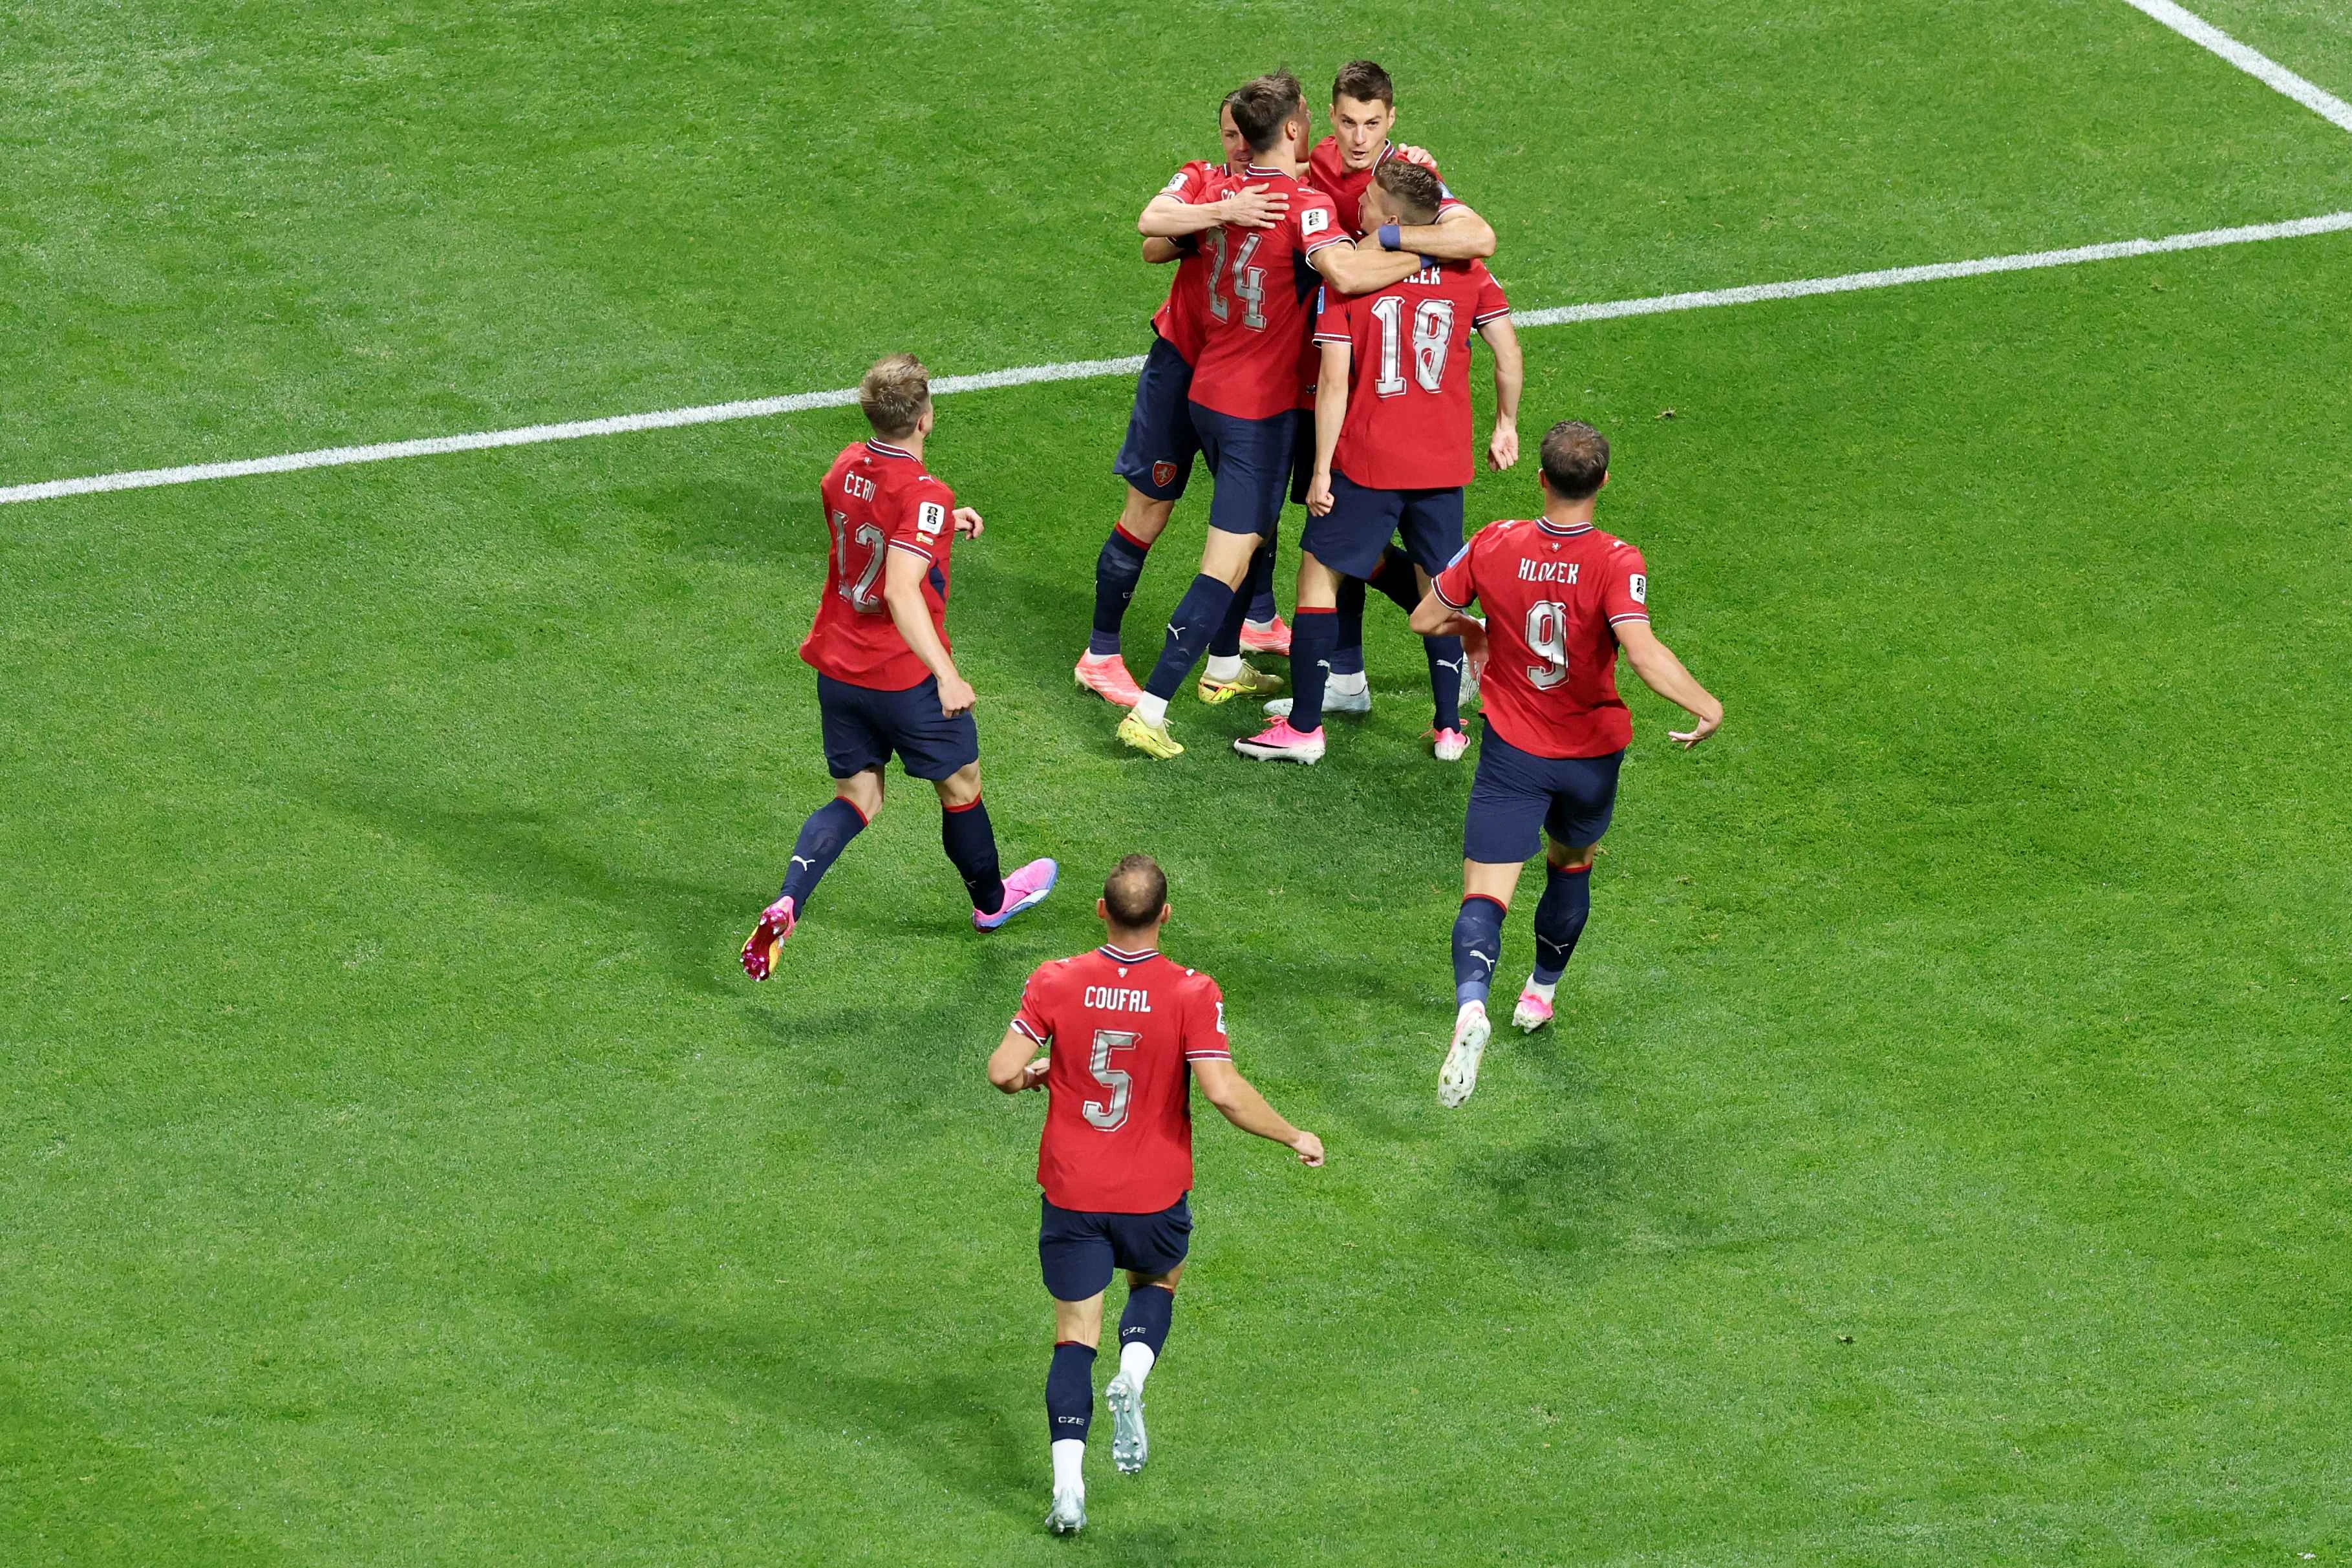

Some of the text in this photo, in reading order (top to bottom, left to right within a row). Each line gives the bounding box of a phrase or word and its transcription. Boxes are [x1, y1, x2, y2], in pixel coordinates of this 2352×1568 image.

[1205, 226, 1268, 332] 24
[1371, 296, 1454, 398] 18
[832, 509, 886, 616] 12
[1525, 600, 1569, 690] 9
[1084, 986, 1151, 1013] COUFAL
[1082, 1029, 1142, 1132] 5
[1122, 1326, 1147, 1337] CZE
[1058, 1416, 1085, 1426] CZE
